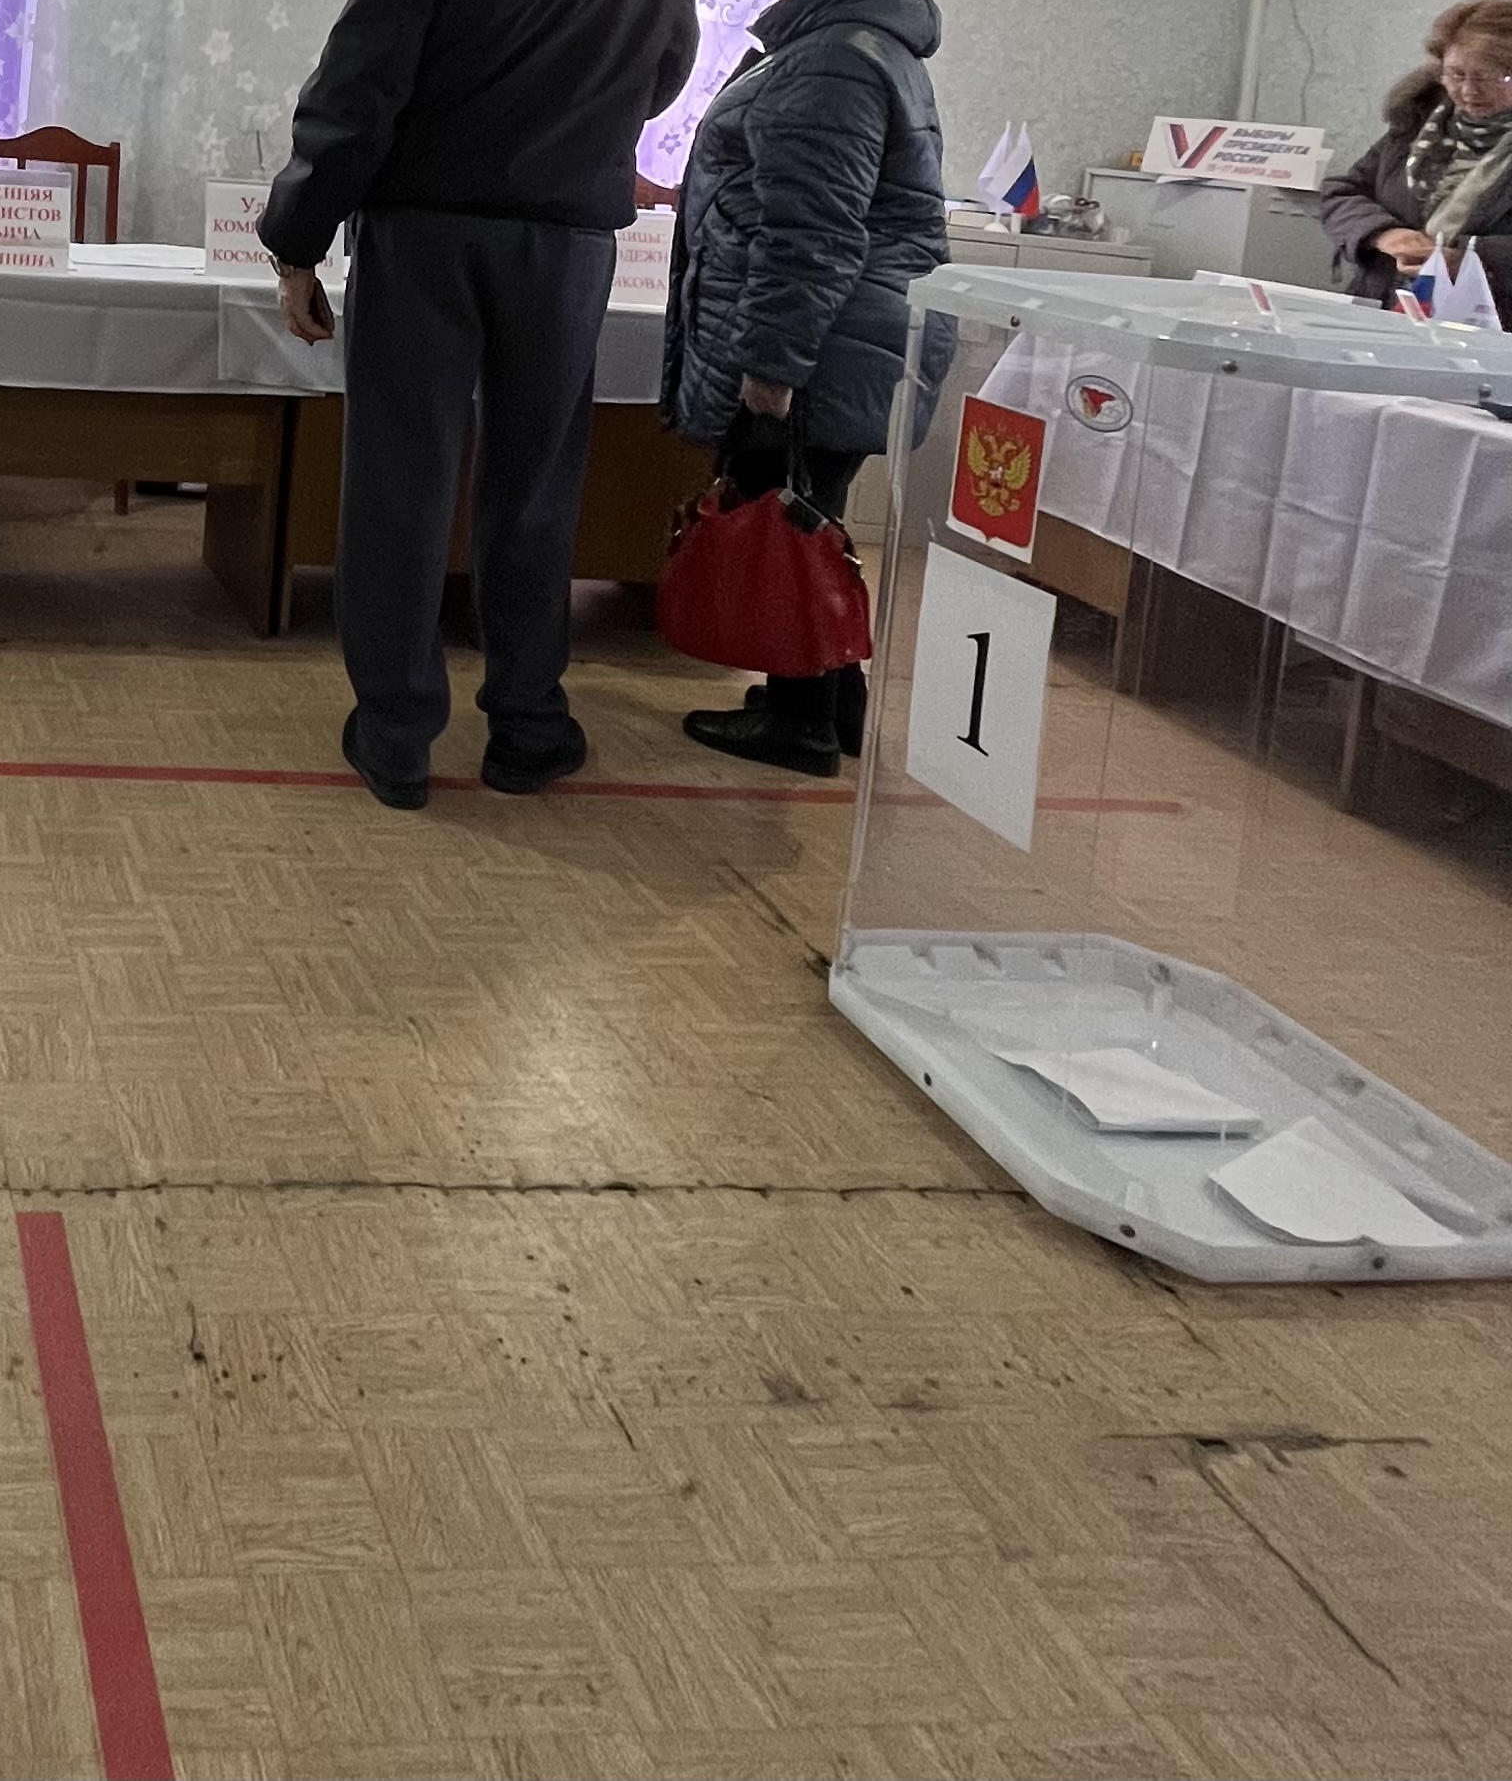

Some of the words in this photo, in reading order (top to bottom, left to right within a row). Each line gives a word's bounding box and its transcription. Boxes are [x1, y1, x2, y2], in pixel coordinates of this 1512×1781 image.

[1212, 151, 1269, 165] РОССИИ
[240, 197, 266, 215] Ул
[213, 219, 256, 235] КОМ
[956, 631, 991, 758] 1
